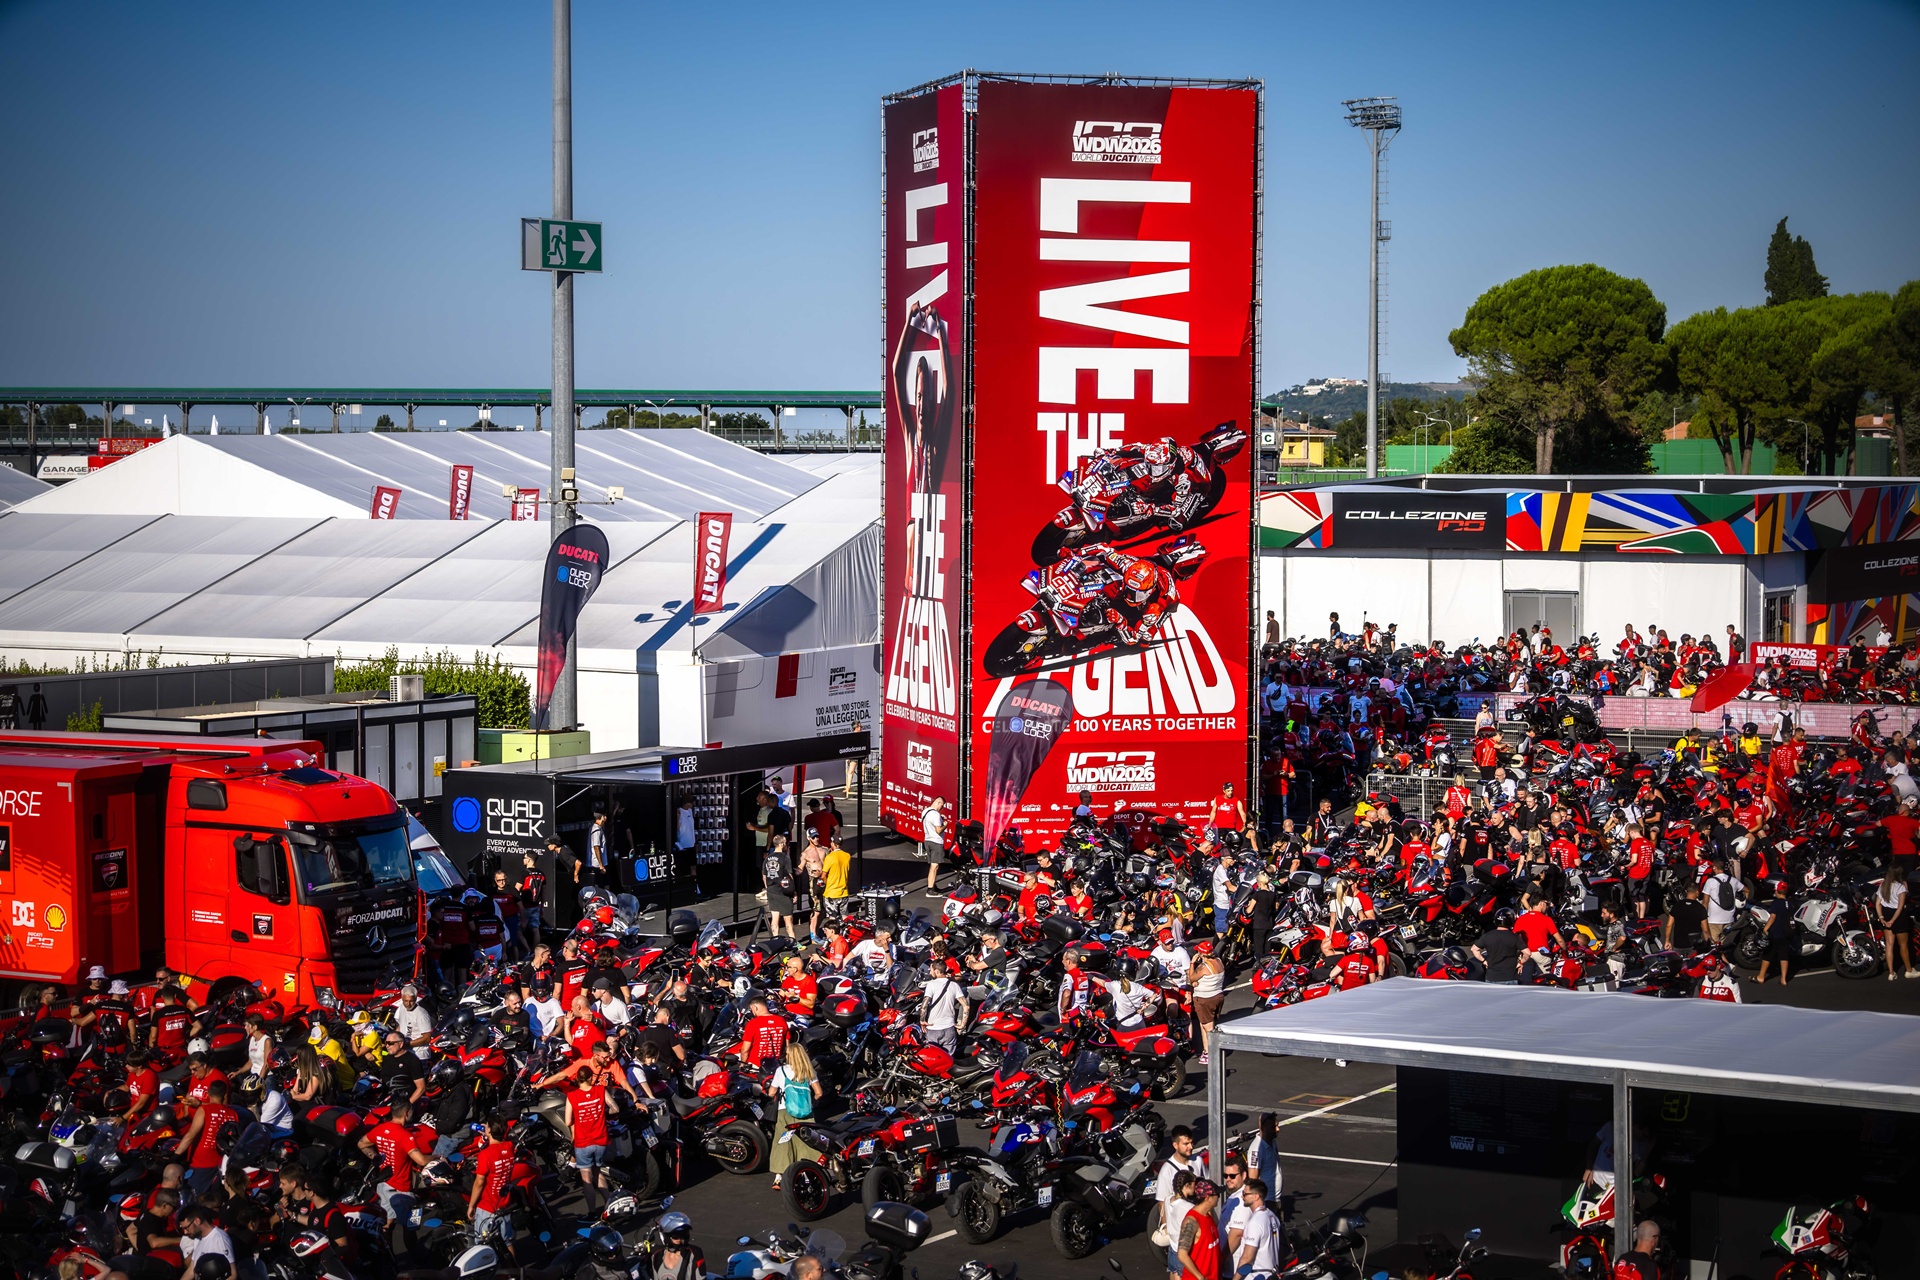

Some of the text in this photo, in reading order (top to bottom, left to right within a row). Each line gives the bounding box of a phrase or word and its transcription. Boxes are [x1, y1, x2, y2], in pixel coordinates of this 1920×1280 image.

[1072, 136, 1162, 154] WDW2026
[1038, 178, 1191, 405] LIVE
[1264, 434, 1272, 443] C
[1345, 511, 1487, 520] COLLEZIONE
[558, 543, 599, 564] DUCATI
[911, 493, 946, 600] THE
[701, 519, 725, 603] DUCATI
[1864, 556, 1919, 570] COLLEZIONE
[569, 567, 592, 581] QUAD
[568, 576, 590, 590] LOCK
[1059, 604, 1080, 614] Lenovo
[886, 596, 956, 717] LEGEND
[1756, 646, 1817, 660] WDW2026
[841, 703, 850, 712] 100
[1011, 696, 1061, 717] DUCATI
[815, 709, 871, 727] UNA LEGGENDA.
[932, 715, 956, 732] TOGETHER
[1024, 719, 1052, 733] QUAD
[1074, 719, 1099, 732] 100
[1102, 718, 1151, 731] YEARS
[1155, 717, 1236, 730] TOGETHER
[1023, 727, 1051, 740] LOCK
[679, 755, 698, 766] QUAD
[679, 764, 698, 774] LOCK
[1067, 766, 1156, 783] WDW2026
[486, 798, 544, 818] QUAD
[486, 816, 544, 838] LOCK
[347, 907, 403, 925] #FORZADUCATI
[1661, 1092, 1691, 1122] 3
[1588, 1210, 1596, 1218] 3
